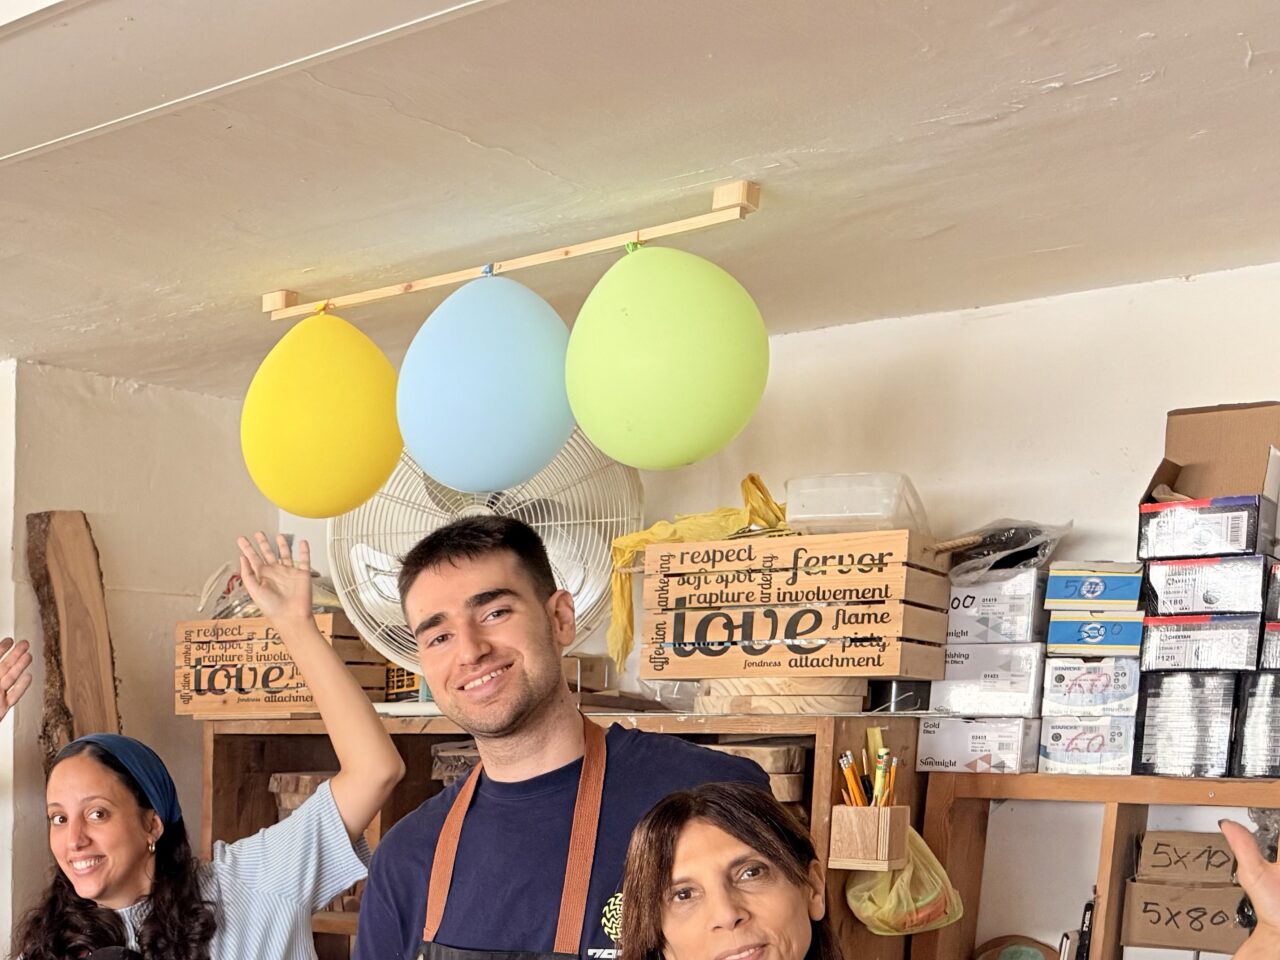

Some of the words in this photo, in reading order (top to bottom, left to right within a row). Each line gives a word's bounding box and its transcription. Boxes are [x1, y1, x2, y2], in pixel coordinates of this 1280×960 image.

[679, 544, 757, 569] respect
[785, 547, 893, 586] fervor
[654, 553, 676, 615] hankeing
[677, 567, 711, 590] soft
[715, 567, 756, 589] spot
[688, 590, 757, 608] rapture
[776, 584, 892, 603] involvement
[672, 596, 828, 658] love
[832, 608, 892, 630] flame
[196, 625, 245, 641] respect
[947, 629, 969, 638] might
[648, 620, 670, 672] affetion
[202, 653, 244, 666] rapture
[742, 660, 782, 670] fondness
[787, 654, 885, 669] attachment
[194, 656, 289, 696] love
[923, 721, 940, 729] Gold
[919, 756, 957, 768] Sunmight
